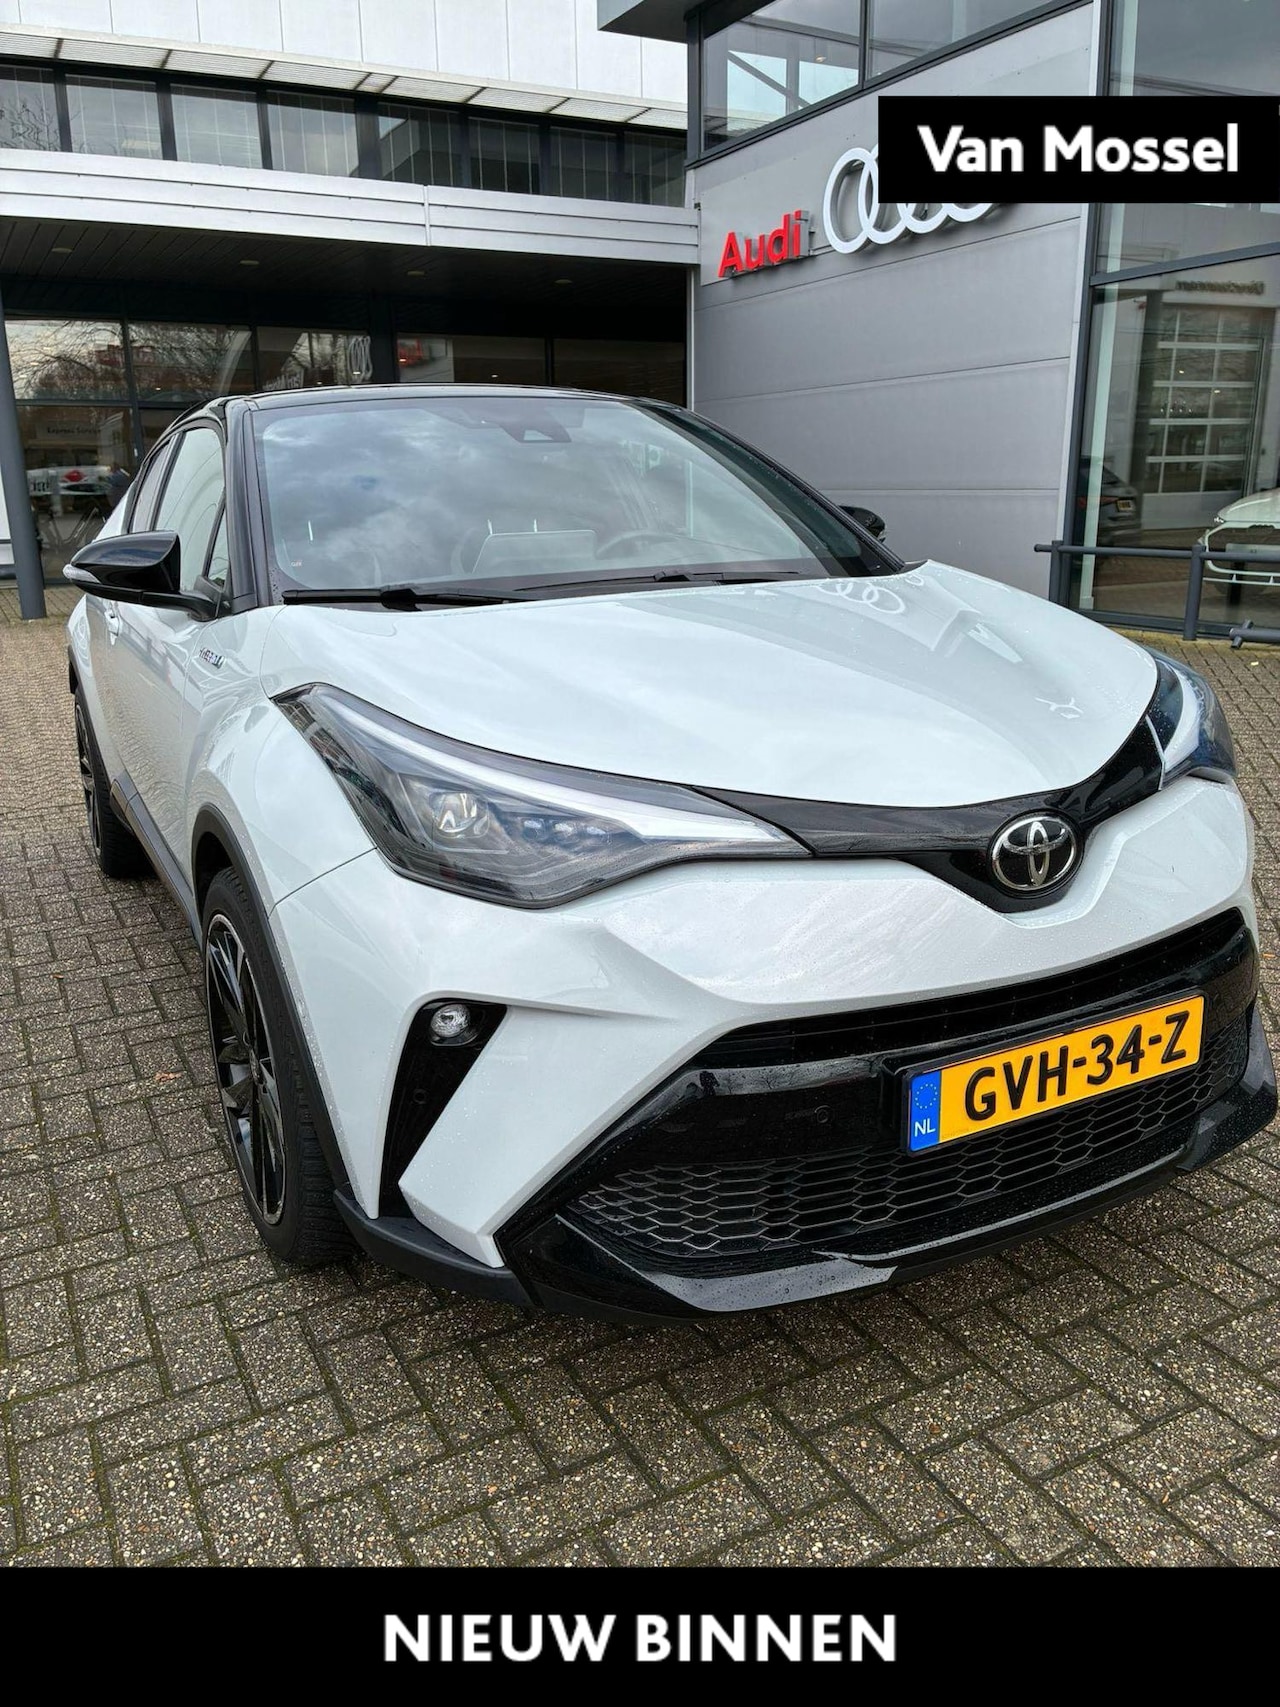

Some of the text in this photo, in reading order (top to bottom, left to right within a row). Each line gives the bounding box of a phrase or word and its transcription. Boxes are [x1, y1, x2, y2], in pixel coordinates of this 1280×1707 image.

[718, 209, 808, 278] Audi
[964, 1010, 1190, 1122] GVH-34-Z
[914, 1117, 936, 1138] NL
